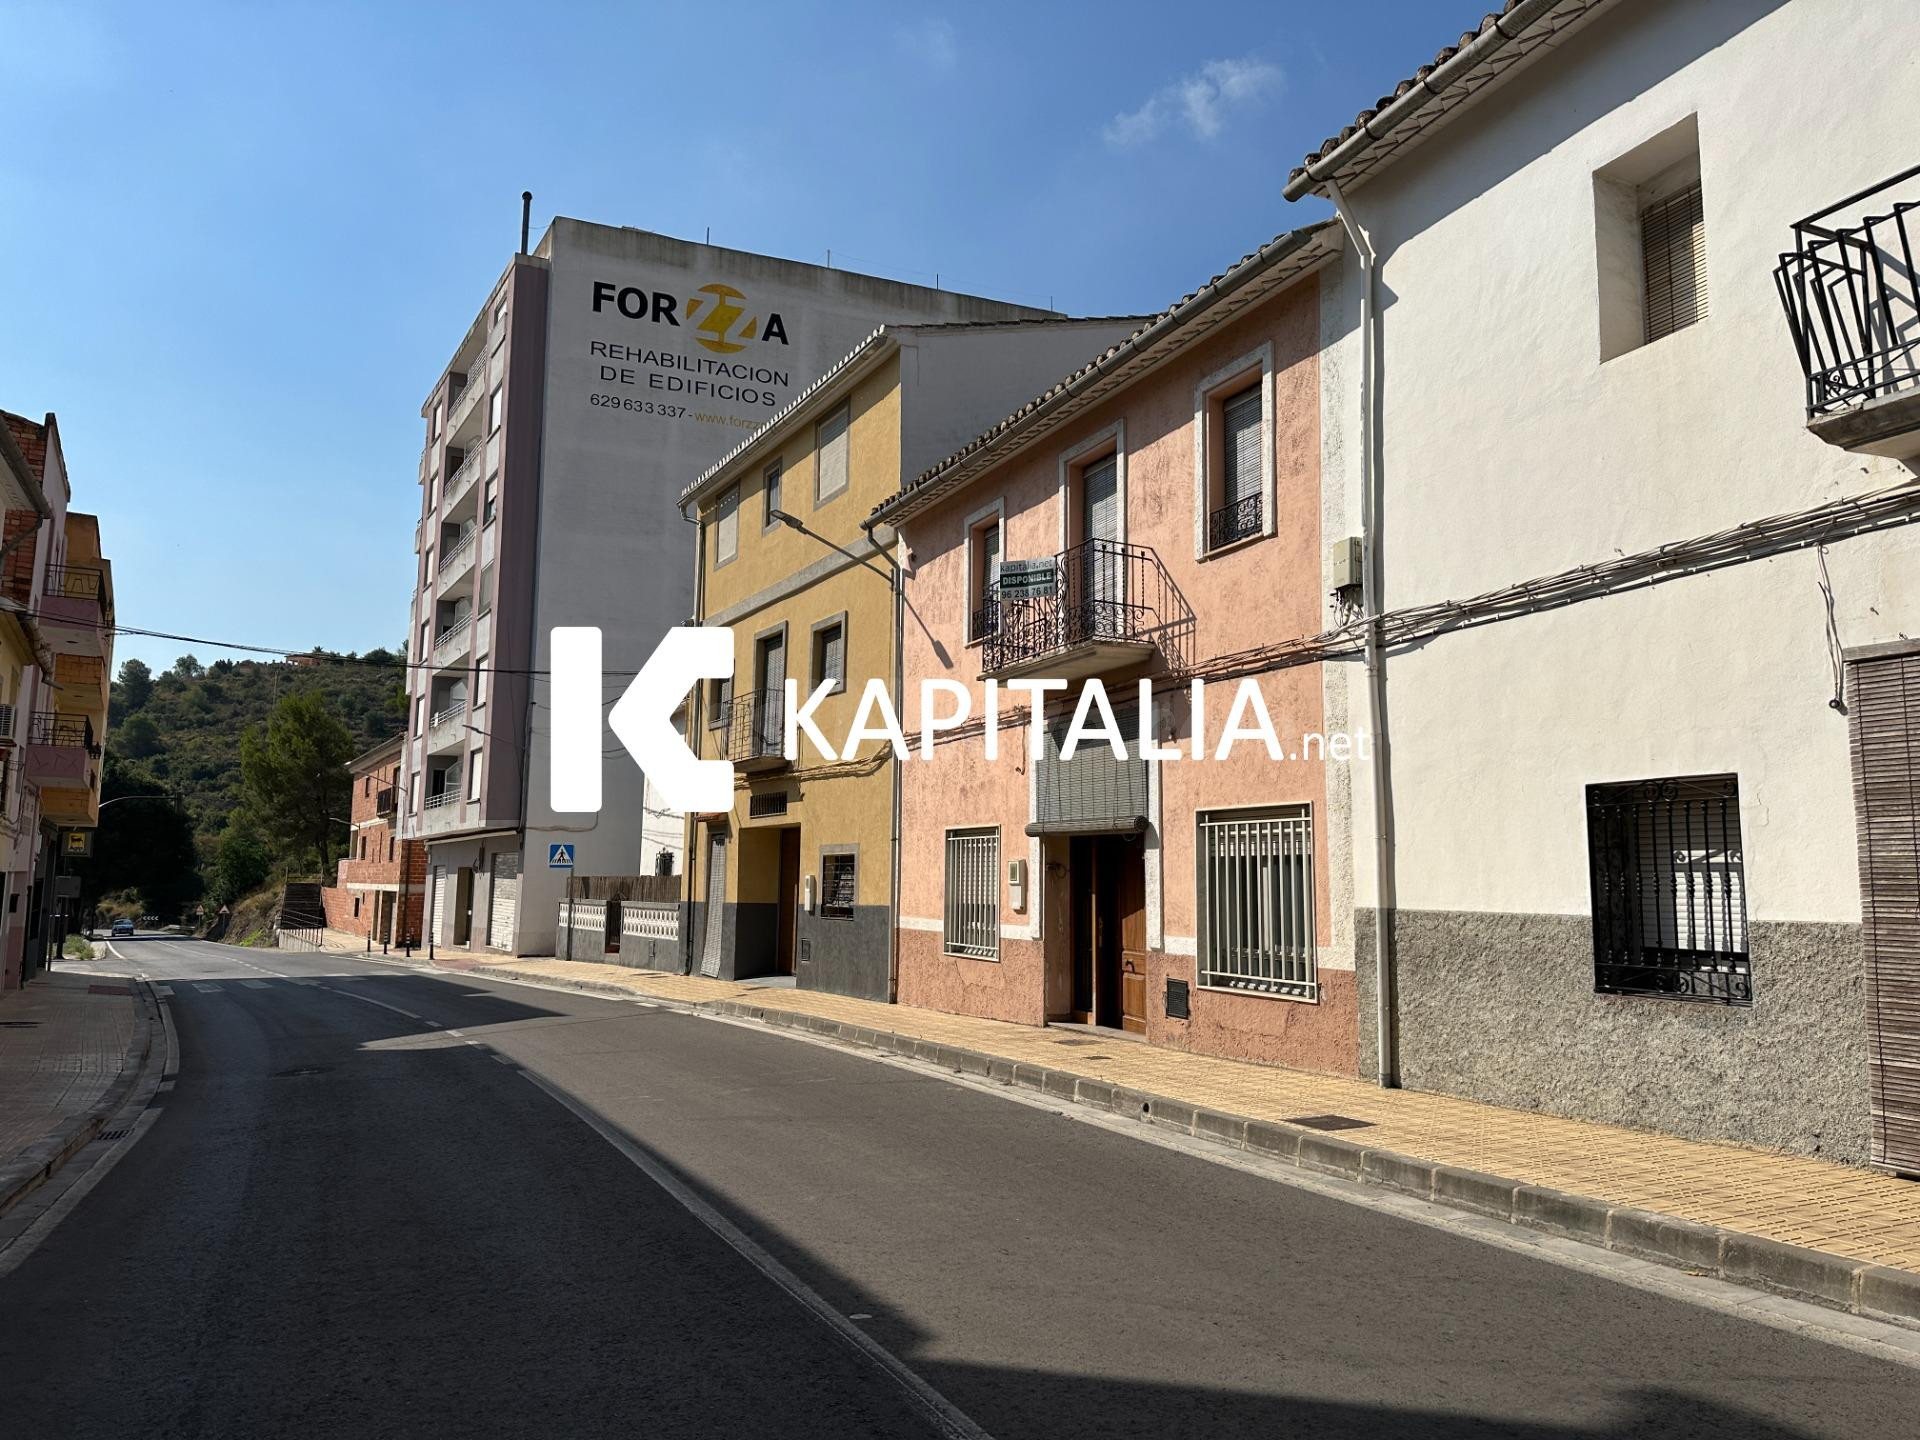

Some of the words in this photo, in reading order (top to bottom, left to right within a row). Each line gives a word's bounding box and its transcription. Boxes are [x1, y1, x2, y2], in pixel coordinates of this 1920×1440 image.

[591, 341, 789, 387] REHABILITACION
[600, 365, 635, 385] DE
[649, 373, 776, 406] EDIFICIOS
[1002, 571, 1052, 585] DISPONIBLE
